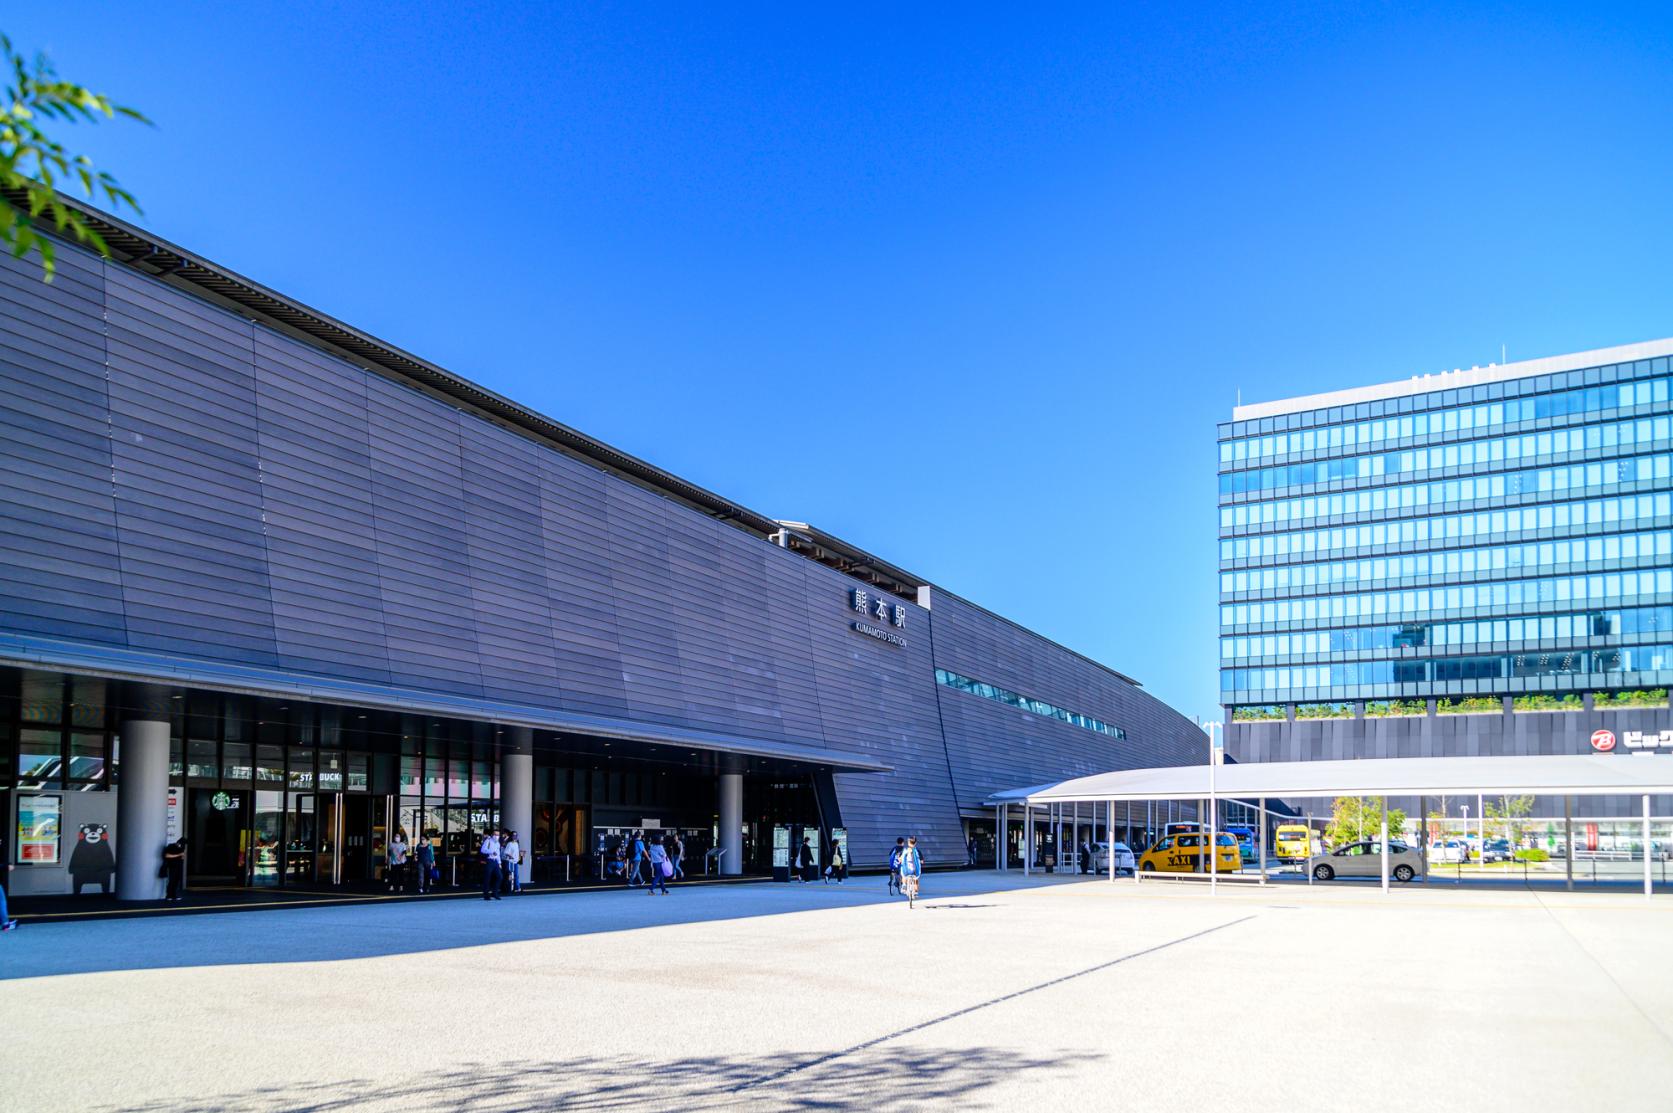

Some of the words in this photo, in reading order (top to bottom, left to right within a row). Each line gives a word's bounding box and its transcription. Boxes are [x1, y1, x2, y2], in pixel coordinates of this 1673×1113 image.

[855, 588, 906, 629] 熊本駅
[855, 622, 887, 641] KUMAMOTO
[887, 633, 908, 647] STATION
[1167, 856, 1191, 865] TAXI
